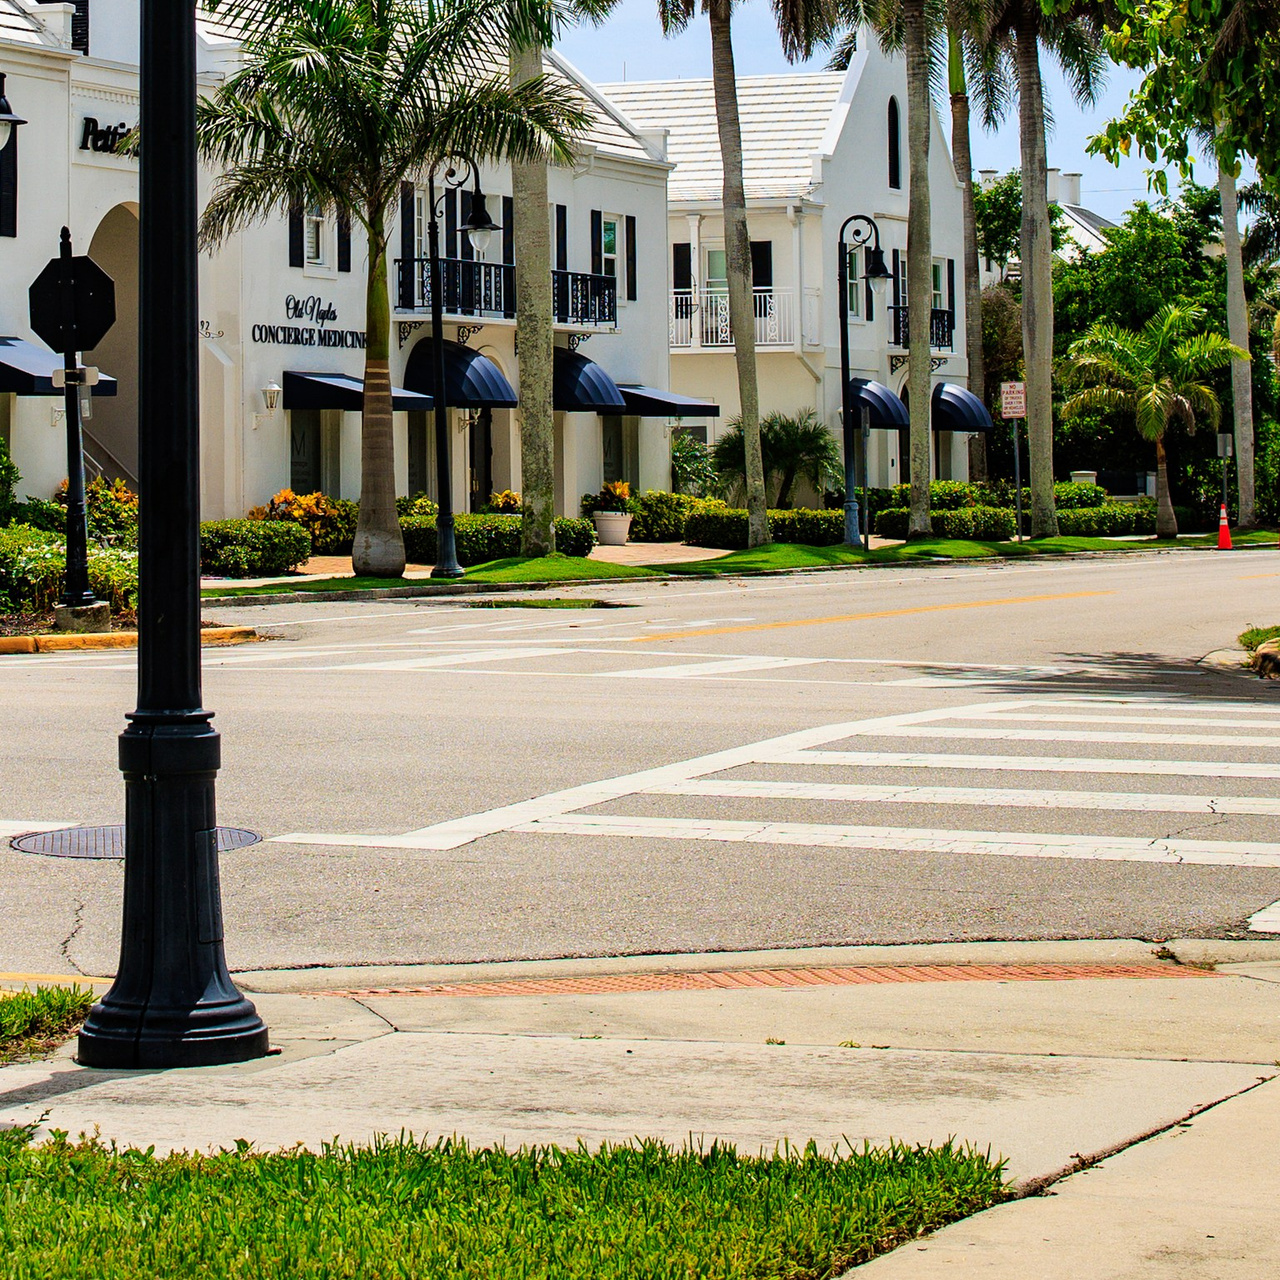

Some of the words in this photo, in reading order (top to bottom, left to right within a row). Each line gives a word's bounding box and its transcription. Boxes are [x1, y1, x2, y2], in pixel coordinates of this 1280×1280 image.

[285, 294, 306, 320] Old
[305, 295, 338, 328] Naples
[252, 324, 316, 347] CONCIERGE
